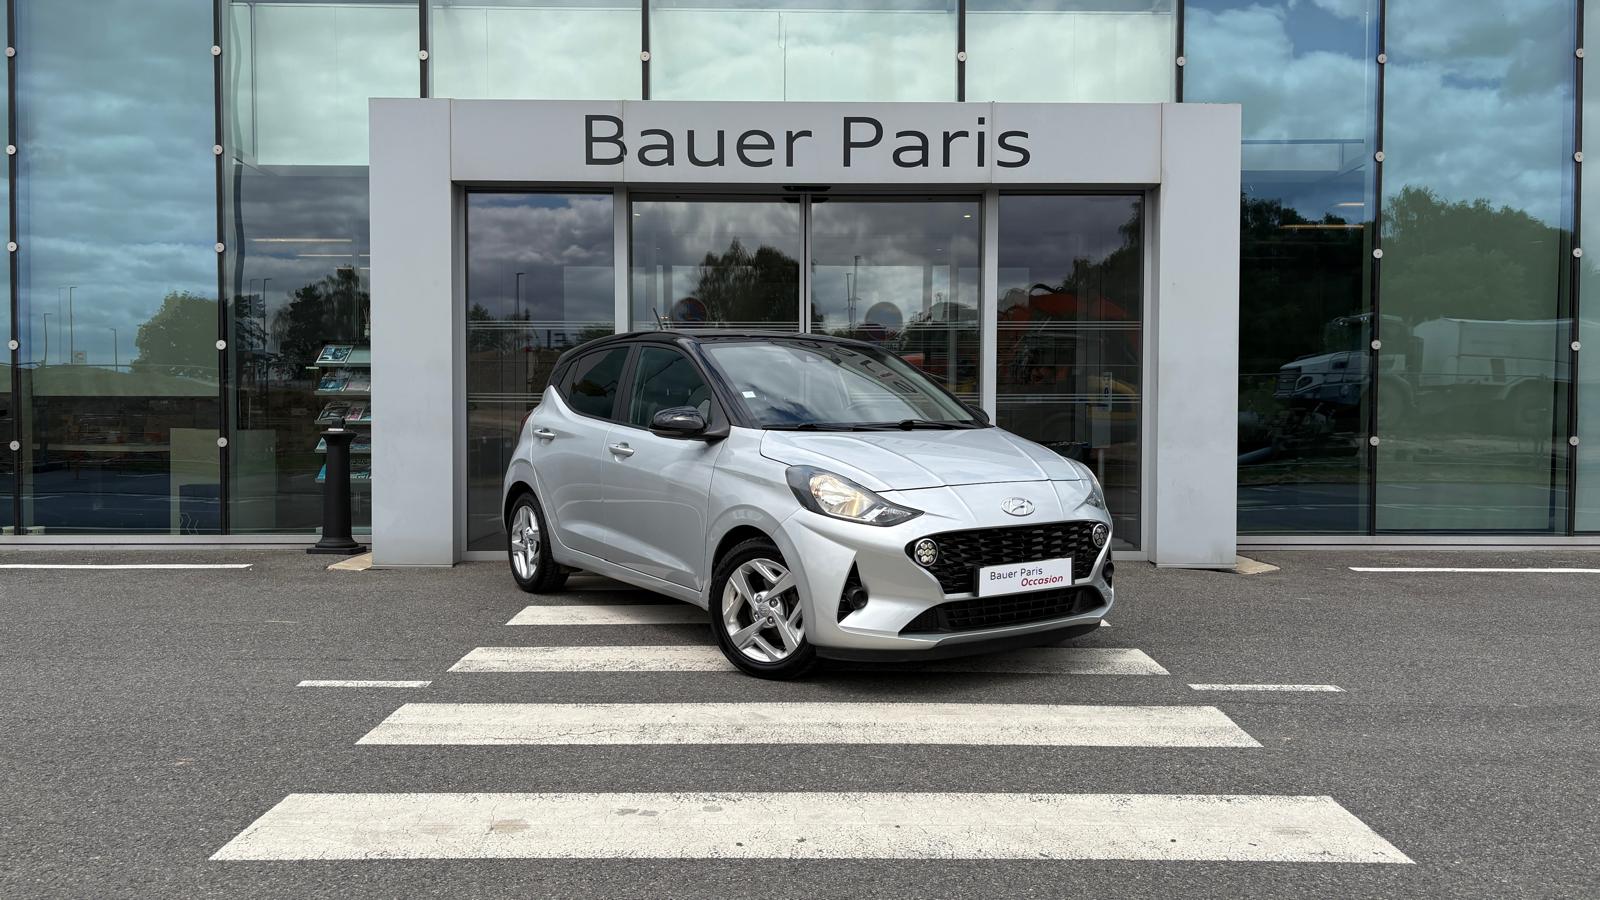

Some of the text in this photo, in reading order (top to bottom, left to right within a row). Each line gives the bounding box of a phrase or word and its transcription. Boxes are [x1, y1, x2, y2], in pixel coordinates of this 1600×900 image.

[585, 114, 1031, 168] Bauer Paris
[990, 567, 1043, 580] Bauer Paris
[1021, 575, 1063, 586] Occasion
